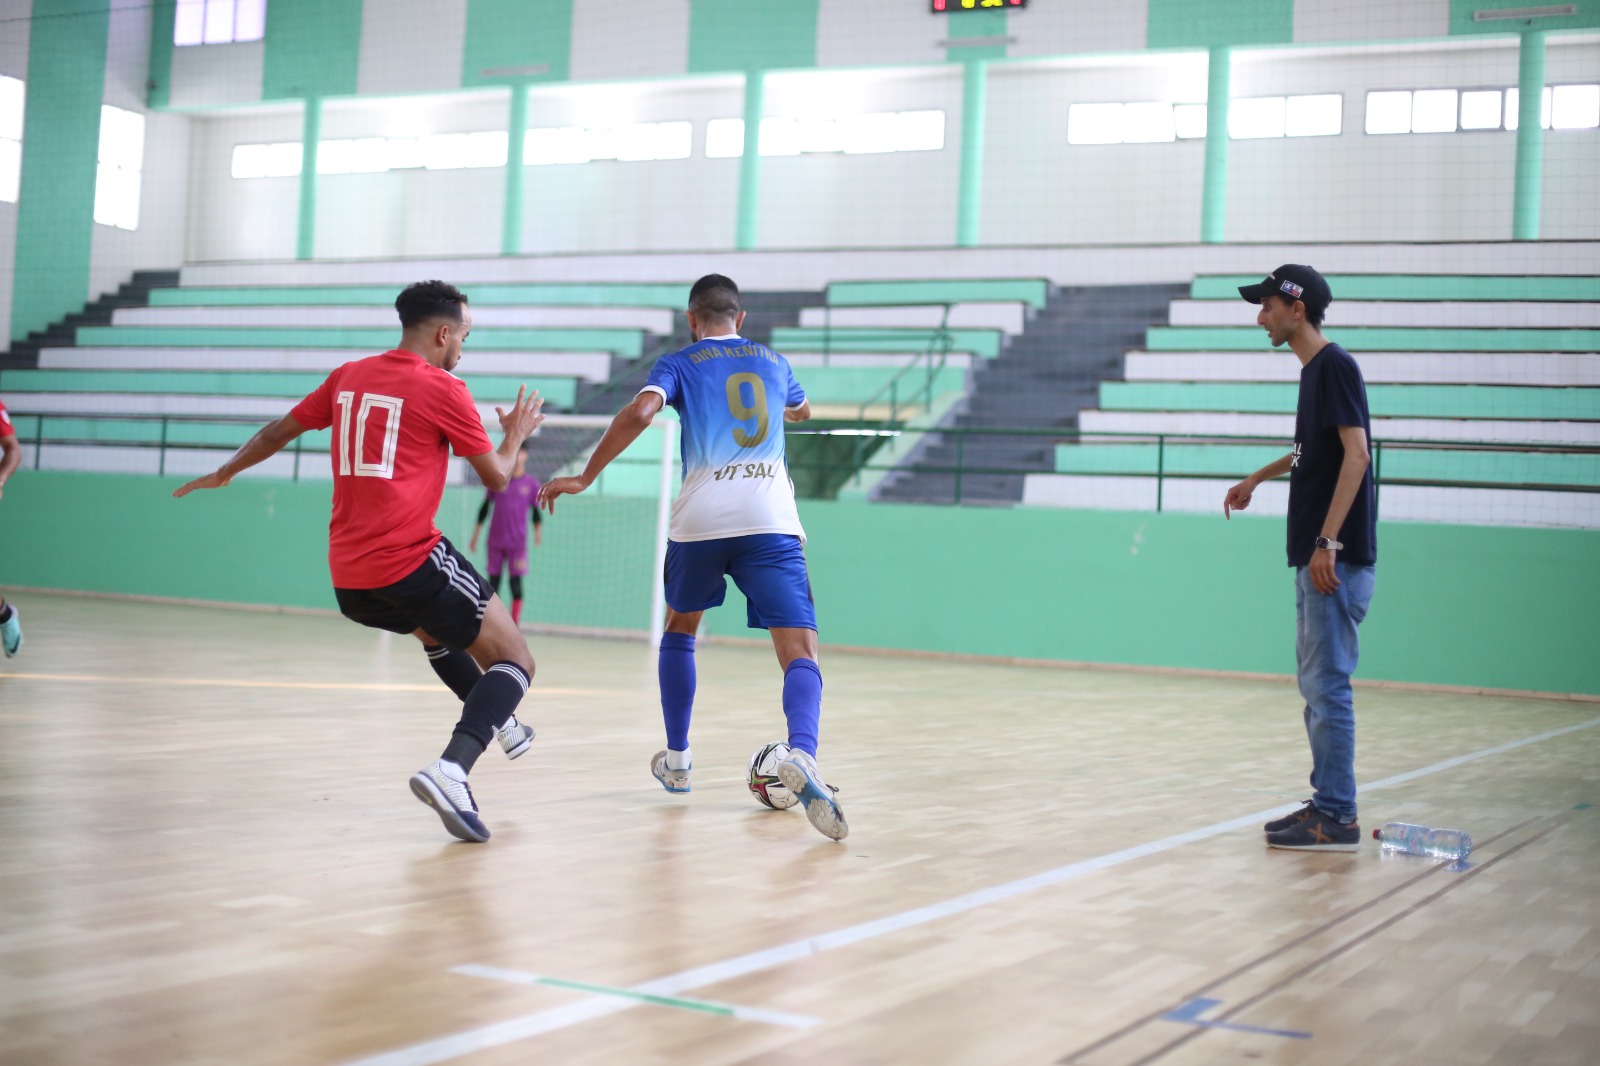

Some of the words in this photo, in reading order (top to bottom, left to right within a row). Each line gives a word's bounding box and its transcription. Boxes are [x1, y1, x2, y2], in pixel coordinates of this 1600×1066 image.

[689, 346, 724, 364] DINA
[726, 372, 769, 448] 9
[337, 391, 404, 479] 10
[742, 462, 775, 479] SAL
